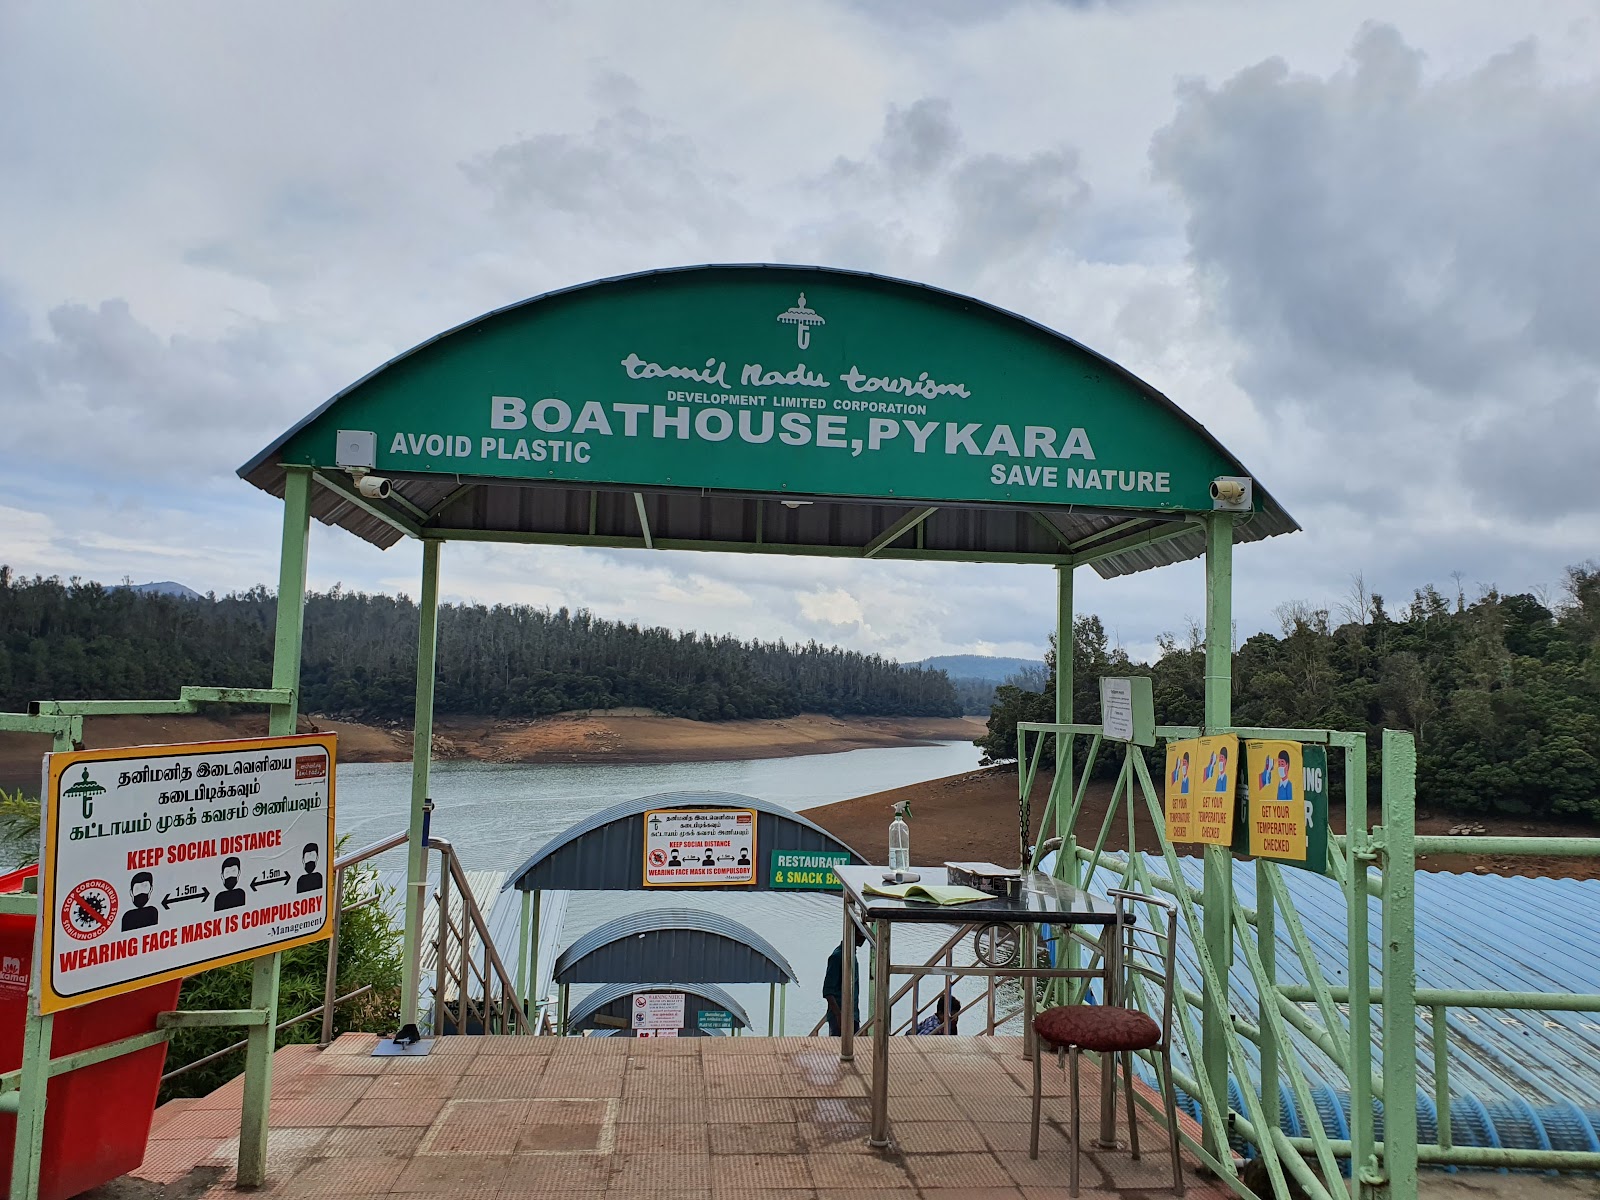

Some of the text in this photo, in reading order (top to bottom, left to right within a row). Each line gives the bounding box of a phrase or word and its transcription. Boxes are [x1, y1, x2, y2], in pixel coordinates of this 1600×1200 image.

[621, 353, 731, 389] tamil
[840, 365, 971, 399] tourism
[667, 391, 927, 415] DEVELOPMENT LIMITED CORPORATION
[389, 432, 592, 464] AVOID PLASTIC
[990, 463, 1171, 493] SAVE NATURE
[117, 763, 193, 789] தனிமனித
[196, 755, 292, 777] இடைவெளியை
[1303, 766, 1323, 793] ING
[158, 777, 261, 804] கடைபிடிக்கவும்
[1202, 797, 1223, 808] GET YOUR
[1261, 805, 1272, 818] GET
[1273, 805, 1290, 819] YOUR
[69, 791, 322, 841] கட்டாயம் முகக் கவசம் அணியவும்
[1198, 811, 1227, 824] TEMPERATURE
[1202, 826, 1220, 839] CHECKED
[1256, 822, 1297, 836] TEMPERATURE
[127, 829, 282, 870] KEEP SOCIAL DISTANCE
[683, 840, 704, 848] SOCIAL
[1263, 838, 1290, 852] CHECKED
[713, 867, 751, 875] COMPULSORY
[777, 855, 847, 869] RESTAURANT
[261, 868, 281, 880] 1.5m
[775, 870, 841, 885] & SNACK BA
[75, 881, 117, 904] CORONAVIRUS
[175, 884, 198, 897] 1.5m
[63, 893, 75, 912] STOP
[106, 907, 117, 926] STOP
[59, 895, 323, 974] WEARING FACE MASK IS COMPULSORY
[63, 920, 106, 940] CORONAVIRUS
[0, 971, 28, 983] kamal
